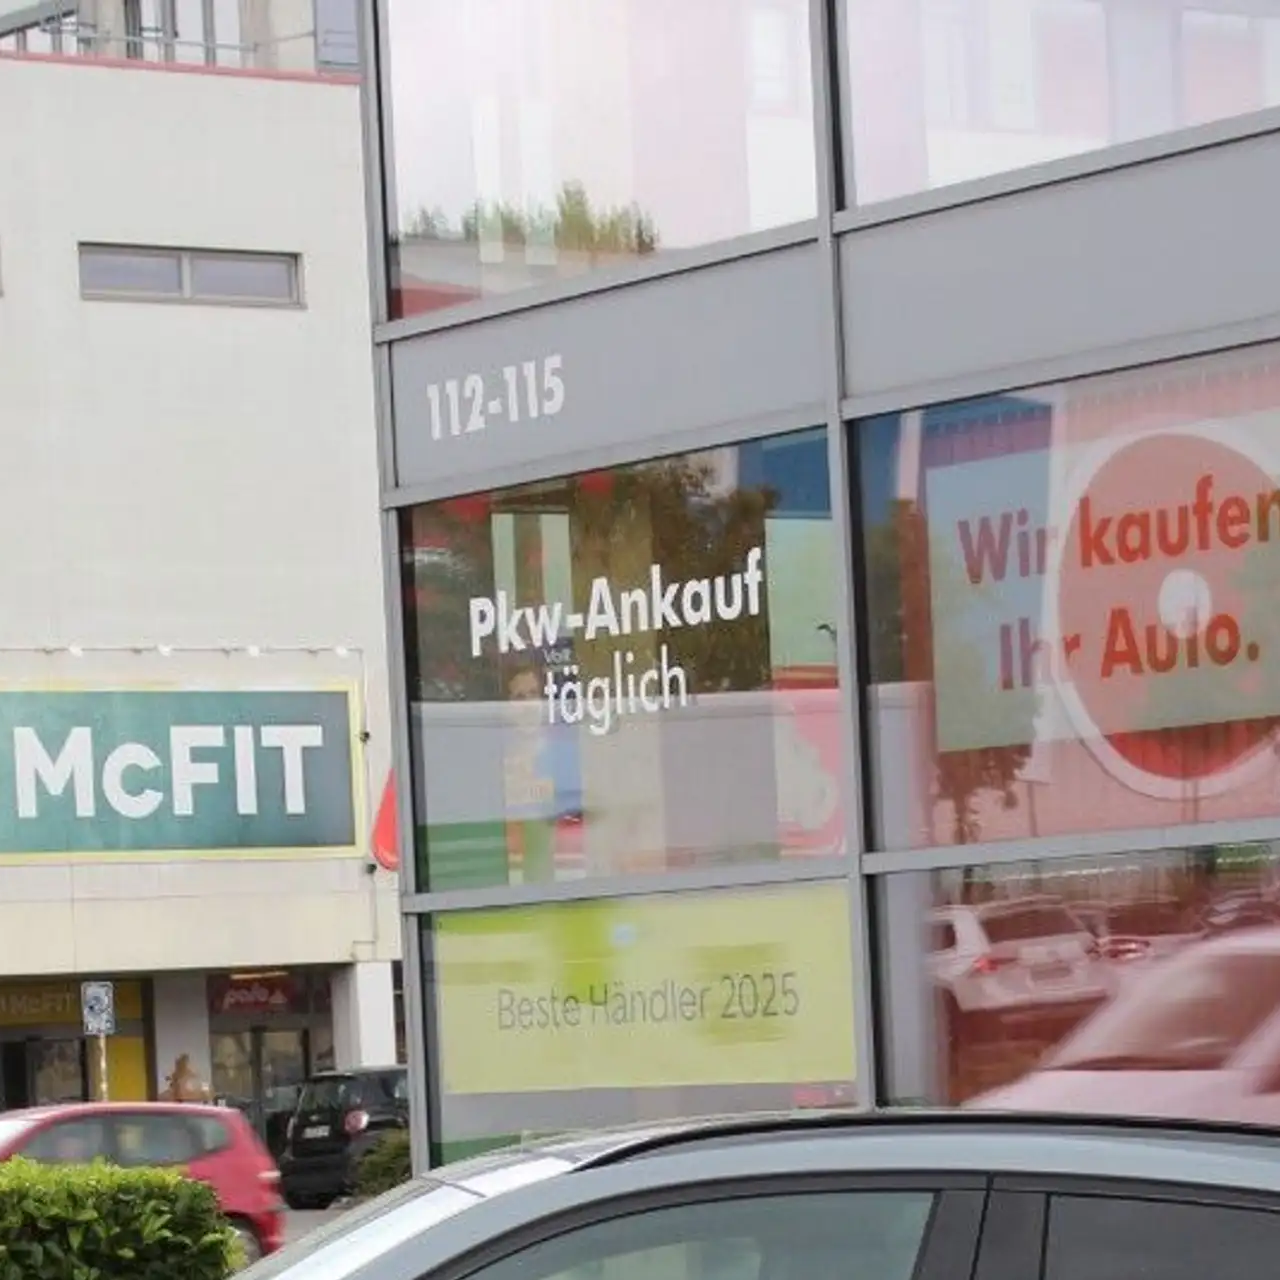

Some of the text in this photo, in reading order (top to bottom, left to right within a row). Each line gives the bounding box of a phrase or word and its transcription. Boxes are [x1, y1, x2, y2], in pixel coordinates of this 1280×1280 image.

[427, 354, 565, 440] 112-115
[958, 508, 1057, 584] Wir
[470, 547, 762, 658] Pkw-Ankauf
[544, 643, 687, 736] täglich
[1000, 608, 1260, 690] Ihr Auto.
[14, 725, 324, 818] McFIT
[497, 972, 800, 1031] Beste Händler 2025
